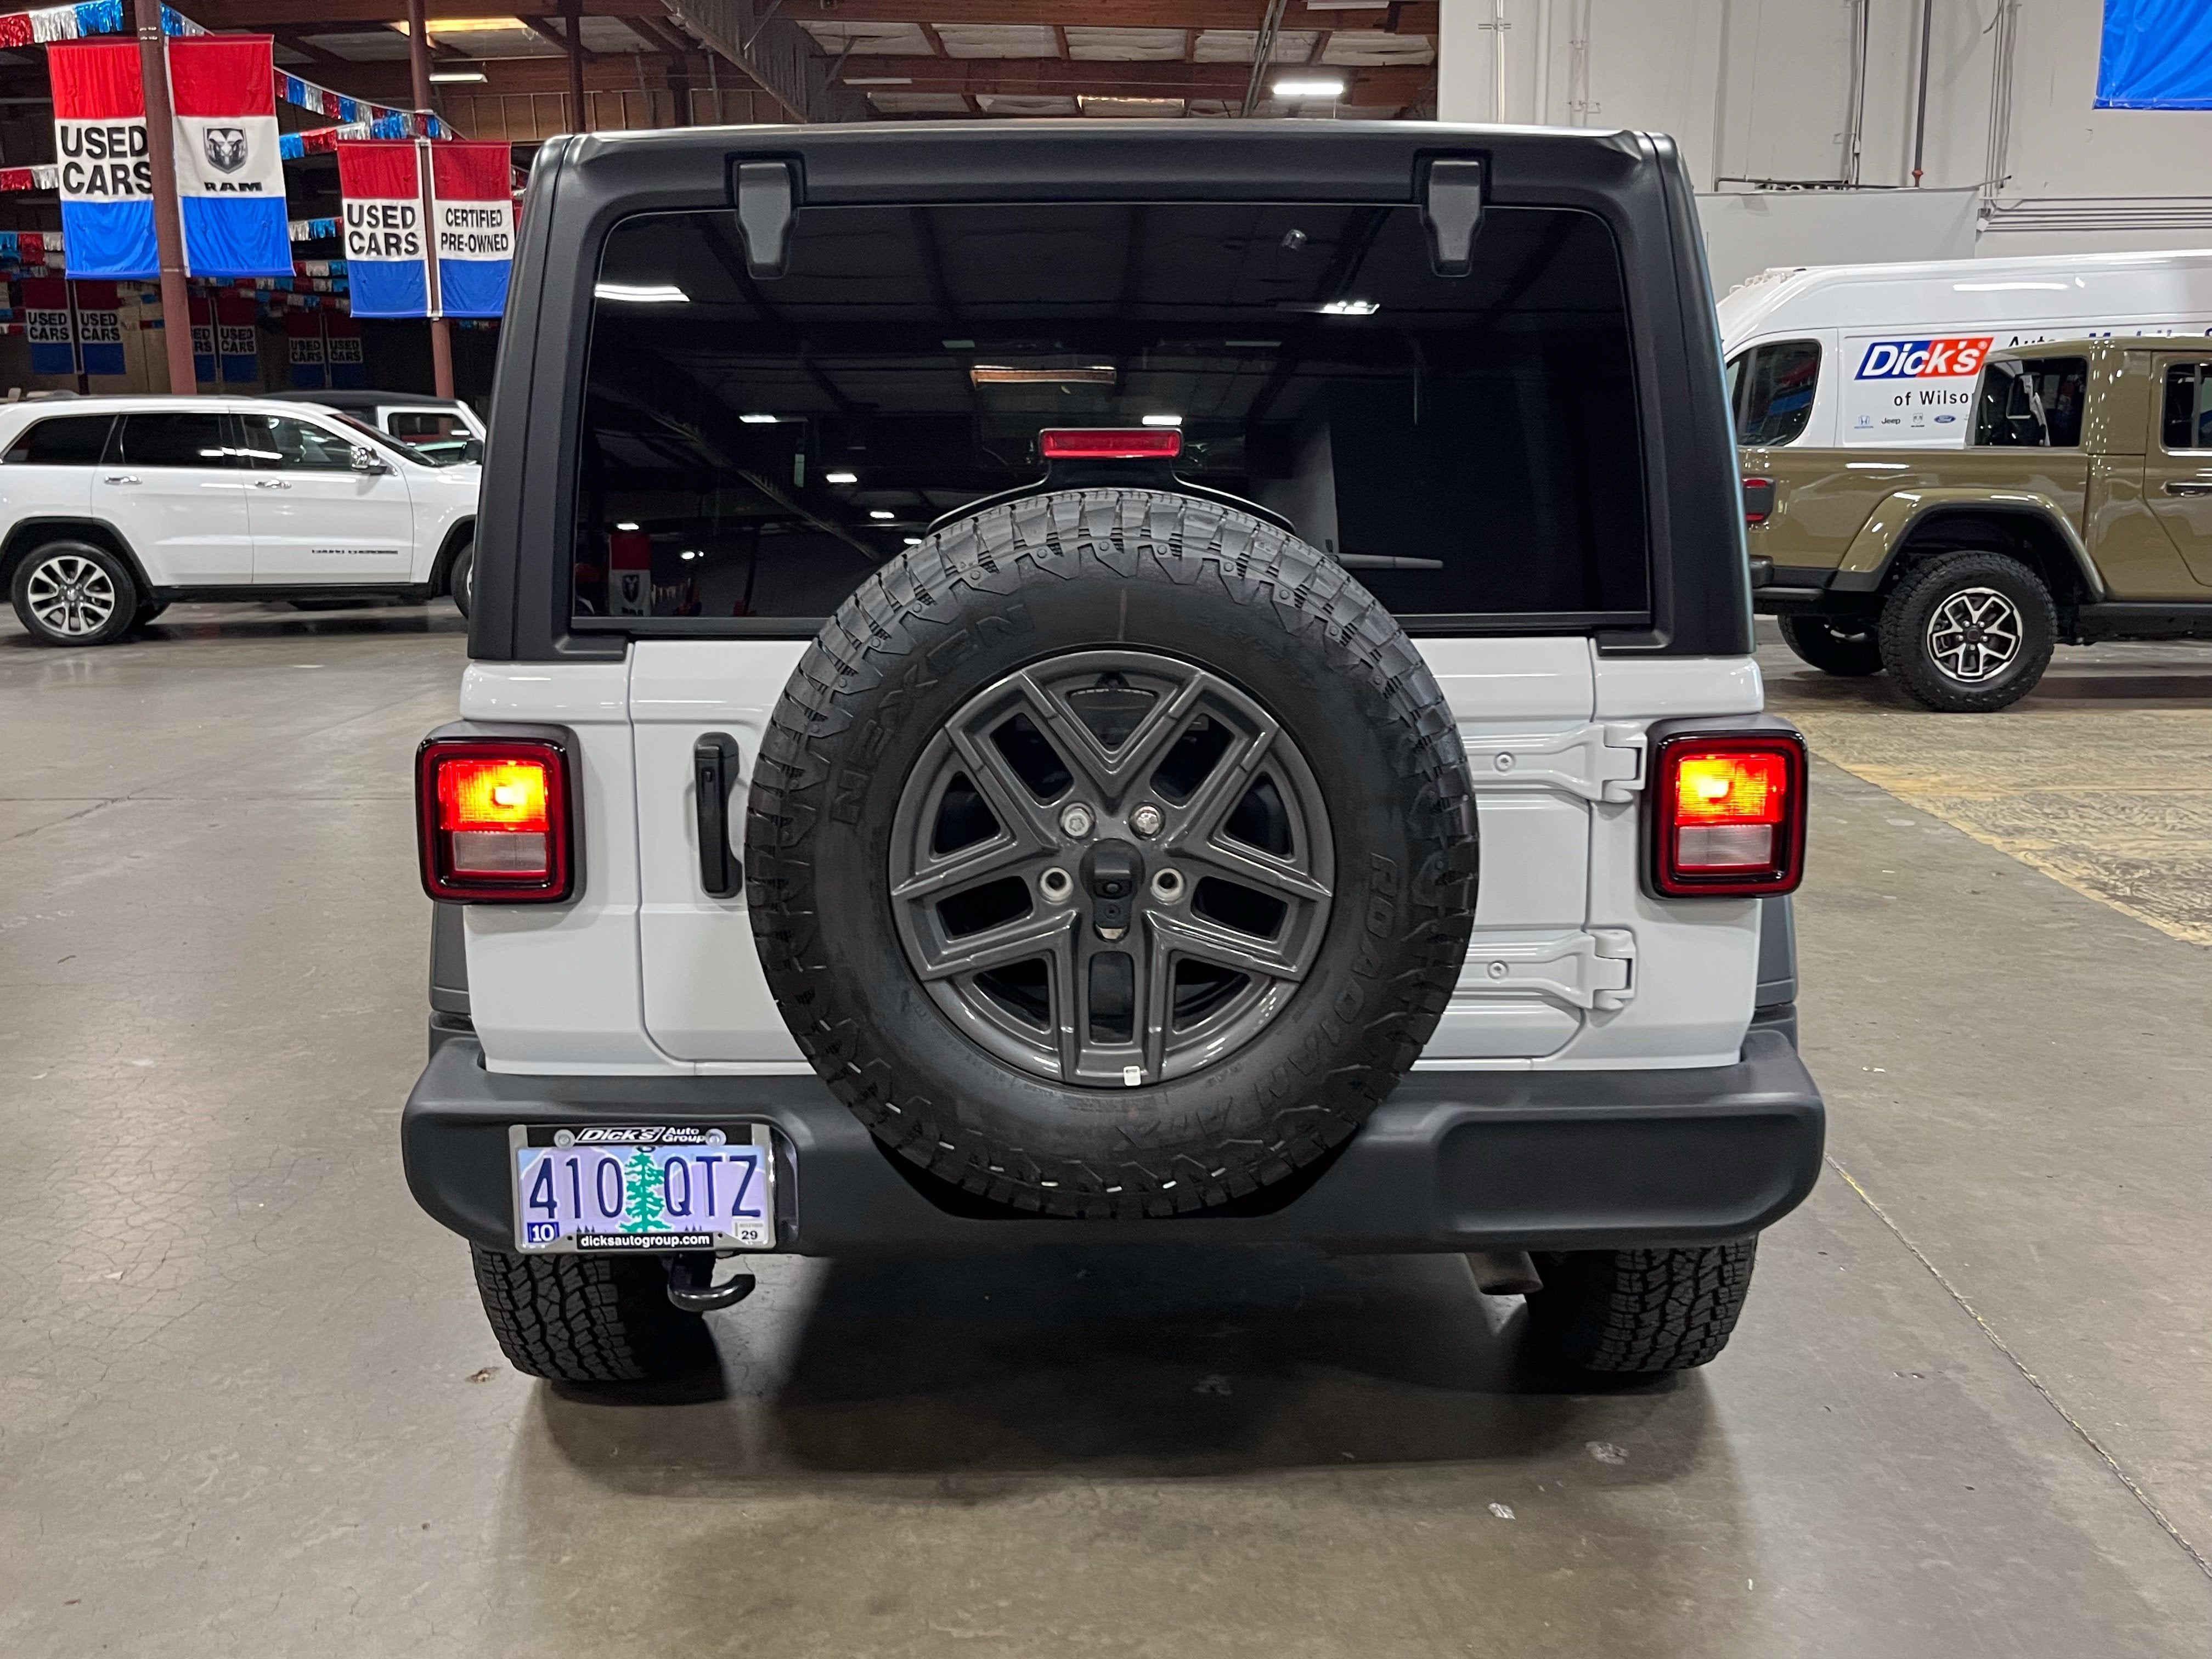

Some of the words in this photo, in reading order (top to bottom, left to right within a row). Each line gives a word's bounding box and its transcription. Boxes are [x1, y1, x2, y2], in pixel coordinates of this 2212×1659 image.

[60, 126, 149, 159] USED
[63, 161, 153, 195] CARS
[204, 181, 263, 193] RAM
[347, 204, 416, 229] USED
[445, 208, 503, 228] CERTIFIED
[348, 230, 420, 256] CARS
[441, 233, 509, 253] PRE-OWNED
[27, 311, 67, 325] USED
[80, 312, 117, 326] USED
[29, 328, 69, 341] CARS
[81, 329, 120, 342] CARS
[193, 328, 210, 340] ED
[221, 328, 253, 340] USED
[195, 341, 212, 353] RS
[221, 341, 255, 352] CARS
[1863, 341, 1979, 376] Dick's
[1894, 392, 1911, 406] of
[1920, 390, 1968, 405] Wilso
[662, 1134, 706, 1143] Group
[666, 1127, 699, 1136] Auto
[529, 1157, 623, 1219] 410
[664, 1155, 761, 1218] QTZ
[531, 1224, 554, 1241] 10
[741, 1230, 758, 1240] 29
[580, 1235, 710, 1248] dicksautogroup.com
